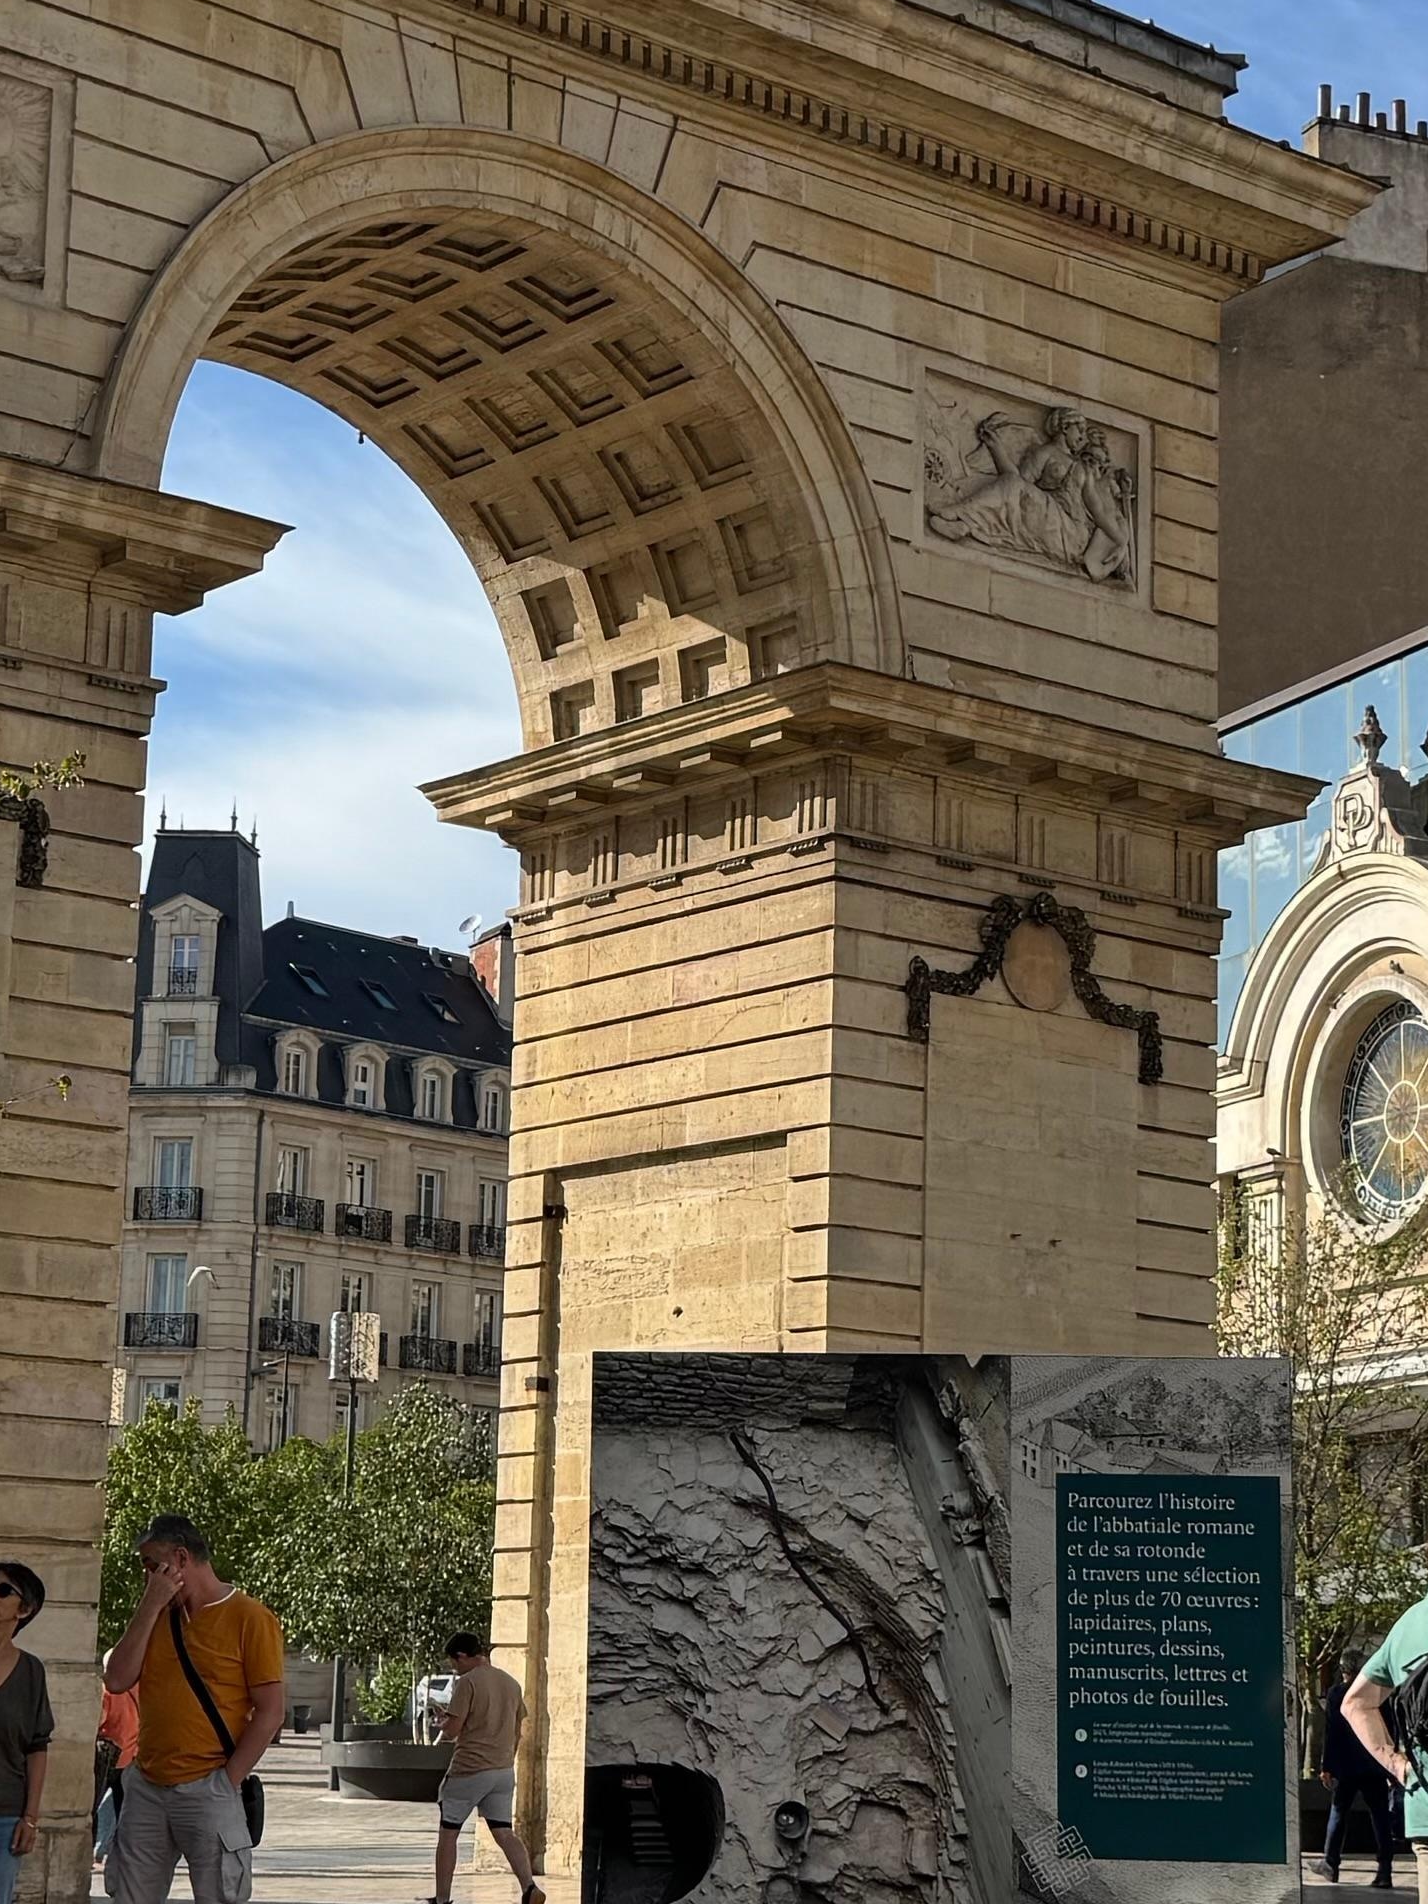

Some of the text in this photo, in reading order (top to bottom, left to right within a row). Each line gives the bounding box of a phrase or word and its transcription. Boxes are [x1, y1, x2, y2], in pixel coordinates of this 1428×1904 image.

[1068, 1492, 1153, 1509] Parcourez
[1067, 1516, 1087, 1532] de
[1187, 1522, 1255, 1535] romane
[1067, 1540, 1206, 1558] et de sa rotonde
[1068, 1565, 1261, 1584] à travers une sélection
[1068, 1589, 1088, 1605] de
[1094, 1589, 1130, 1610] plus
[1135, 1590, 1155, 1606] de
[1161, 1591, 1180, 1607] 70
[1069, 1613, 1212, 1636] lapidaires, plans,
[1069, 1638, 1225, 1660] peintures, dessins,
[1069, 1664, 1249, 1683] manuscrits, lettres et
[1069, 1687, 1228, 1708] photos de fouilles.
